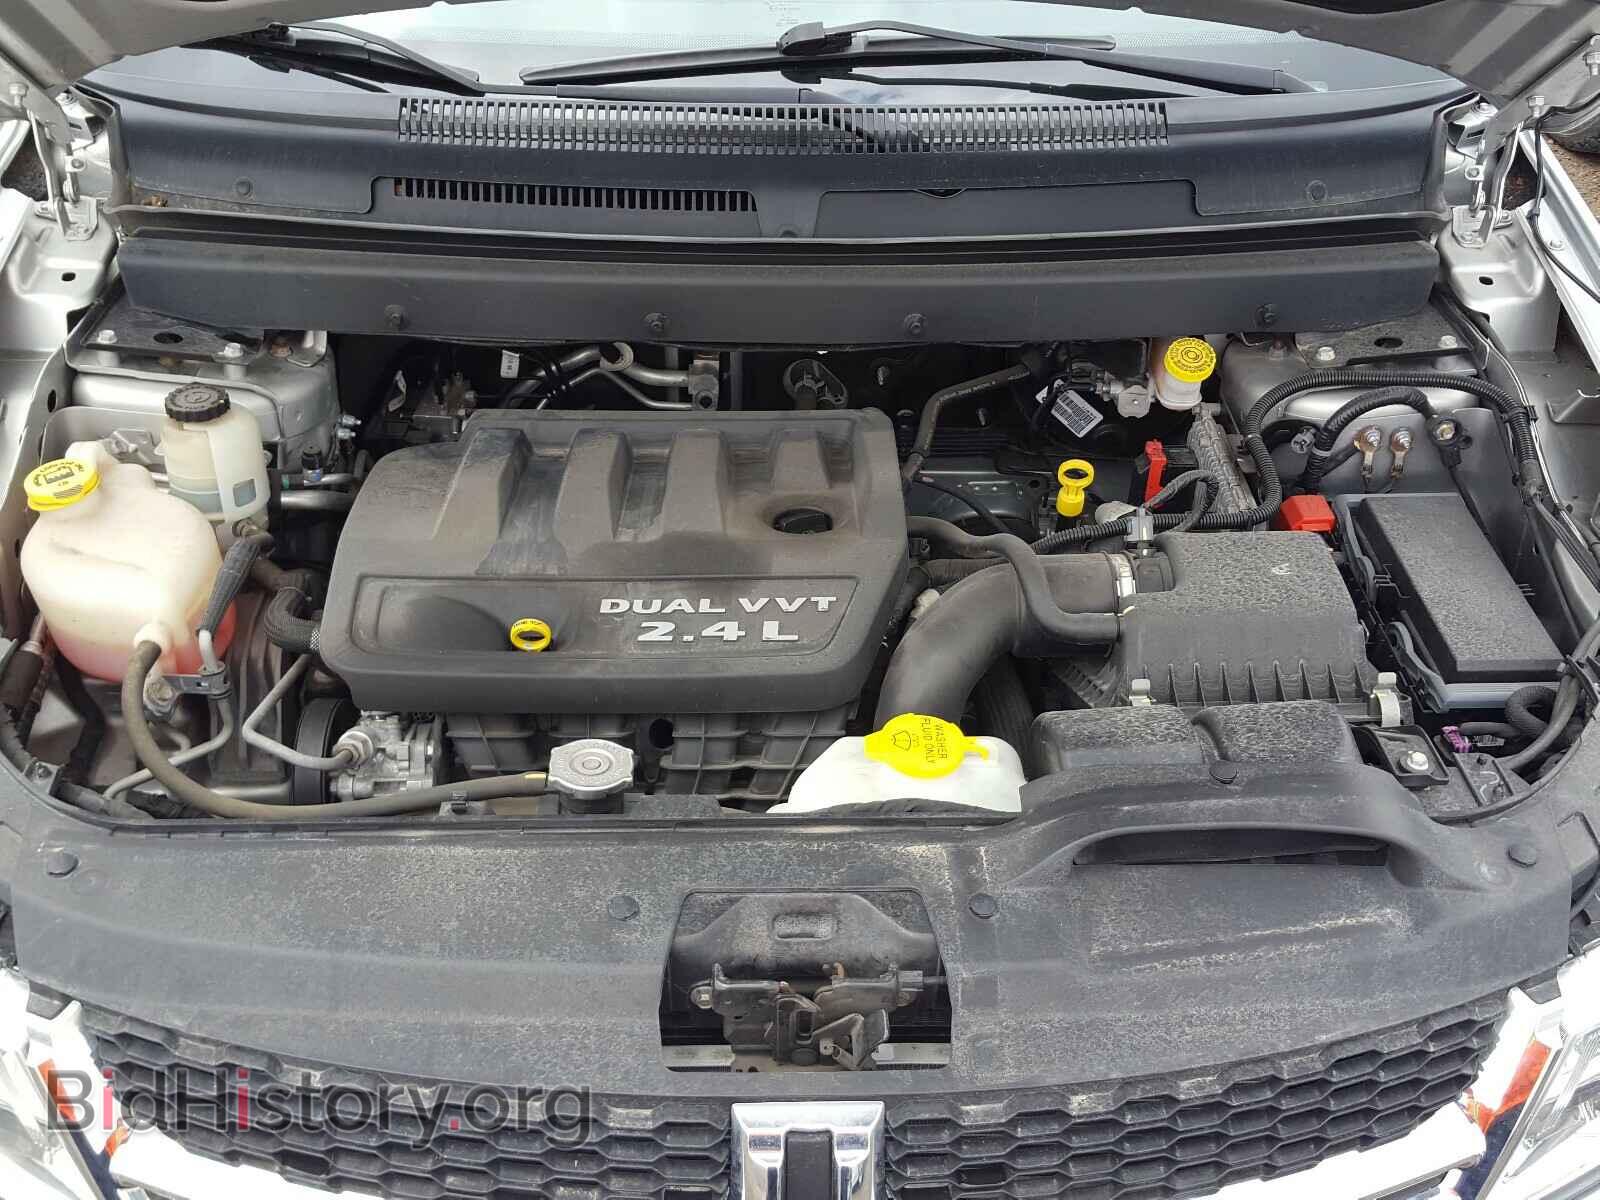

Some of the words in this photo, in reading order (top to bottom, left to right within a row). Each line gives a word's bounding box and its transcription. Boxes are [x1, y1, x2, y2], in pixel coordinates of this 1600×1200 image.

[599, 598, 727, 614] DUAL
[738, 596, 838, 613] VVT
[921, 718, 933, 742] FLUID
[935, 723, 948, 759] WASHER
[924, 744, 936, 764] ONLY
